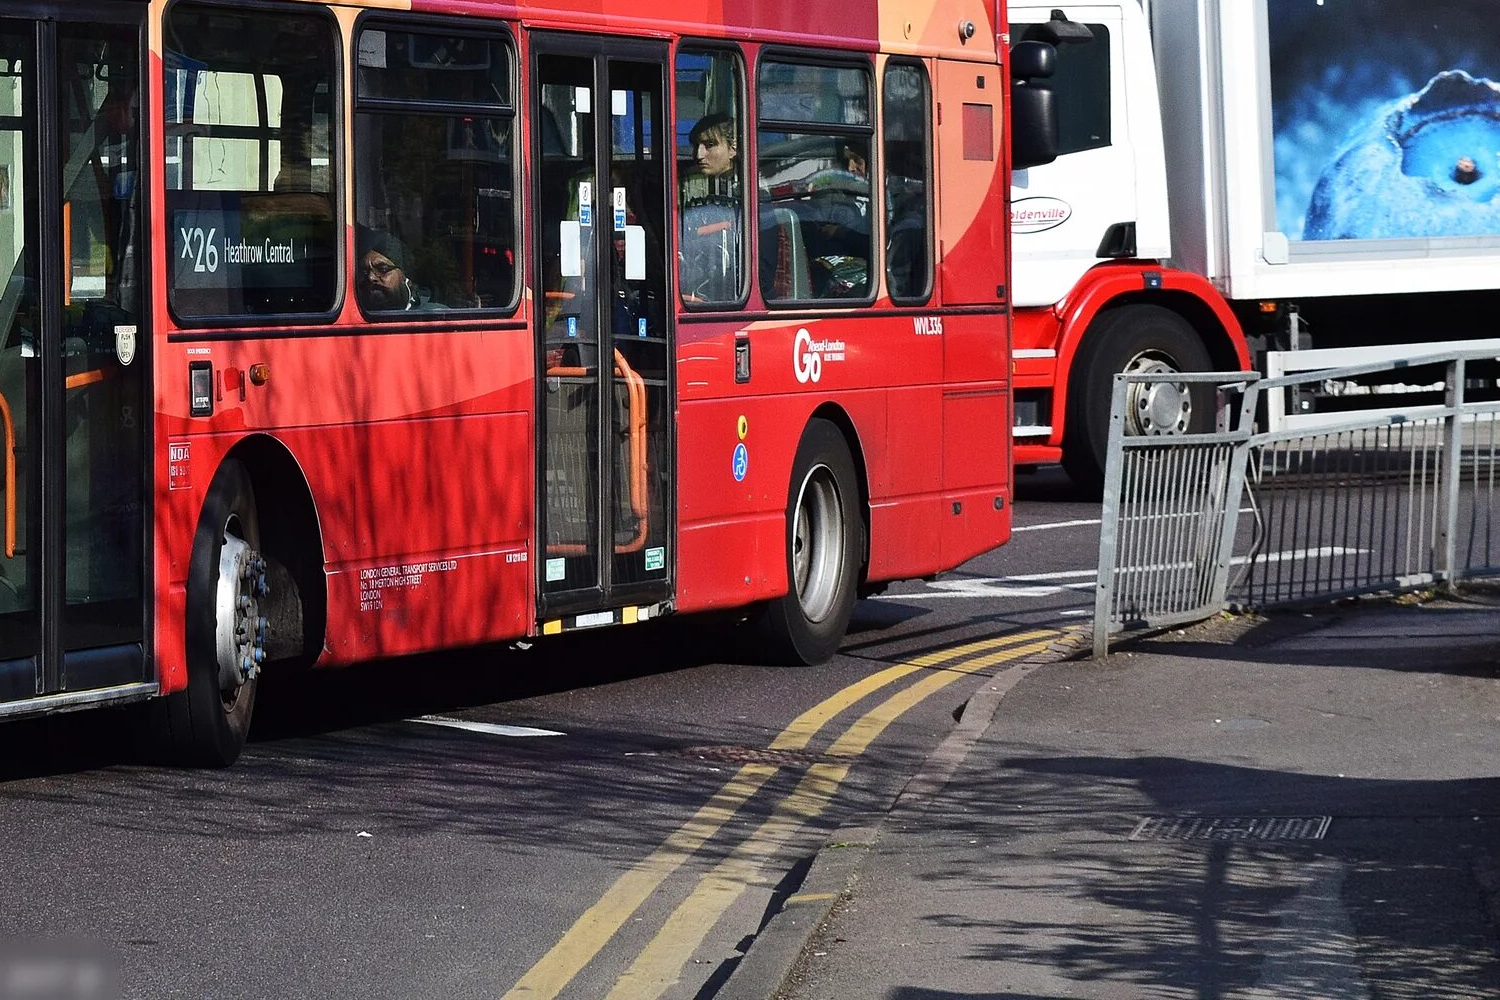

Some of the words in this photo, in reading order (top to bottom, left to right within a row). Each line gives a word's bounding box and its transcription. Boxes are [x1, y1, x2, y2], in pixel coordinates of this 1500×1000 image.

[1011, 208, 1065, 220] oldenville
[180, 227, 219, 273] X26
[224, 237, 263, 264] Heathrow
[264, 237, 295, 264] Central
[913, 317, 943, 335] WVL336
[794, 328, 821, 383] Go
[360, 569, 380, 580] LONDON
[381, 566, 401, 577] GENERAL
[402, 563, 428, 574] TRANSPORT
[428, 561, 448, 572] SERVICES
[448, 560, 457, 570] LTD
[375, 578, 394, 588] MERTON
[394, 576, 407, 586] HIGH
[406, 574, 422, 585] STREET
[360, 590, 381, 601] LONDON
